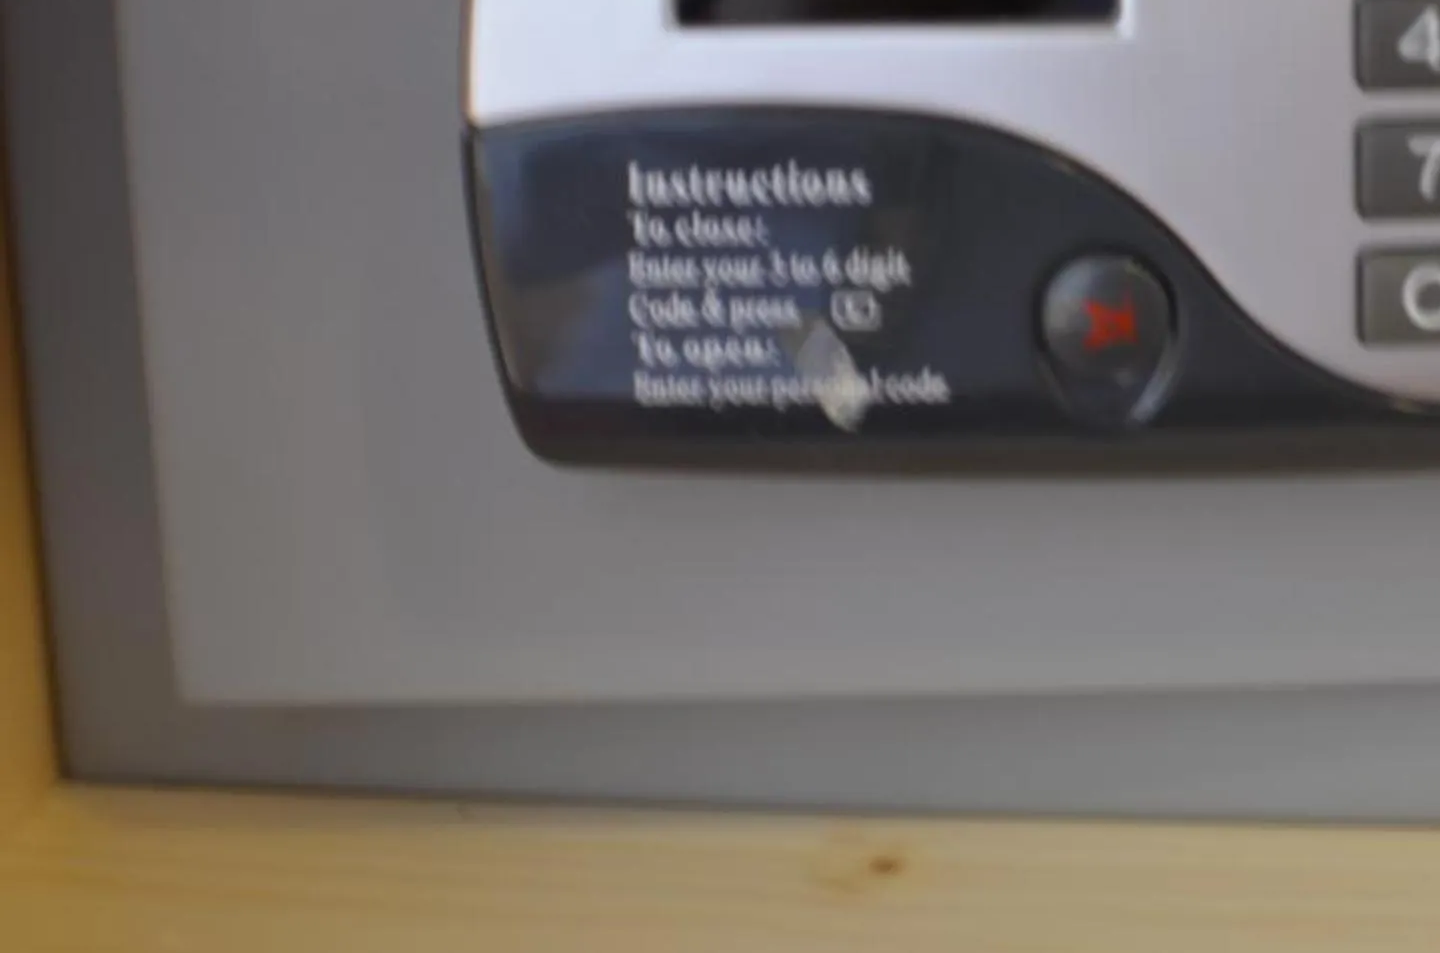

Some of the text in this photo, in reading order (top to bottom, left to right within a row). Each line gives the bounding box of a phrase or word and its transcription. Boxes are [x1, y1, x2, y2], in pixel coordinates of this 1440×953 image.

[628, 159, 872, 207] Instructions
[628, 211, 672, 246] To
[628, 250, 700, 288] Enter
[701, 254, 764, 290] your
[790, 250, 821, 286] to
[845, 246, 911, 293] digit
[628, 290, 698, 329] Code
[729, 294, 801, 334] press
[632, 332, 679, 368] To
[634, 371, 704, 407] Enter
[706, 374, 767, 412] your
[884, 365, 950, 405] code
